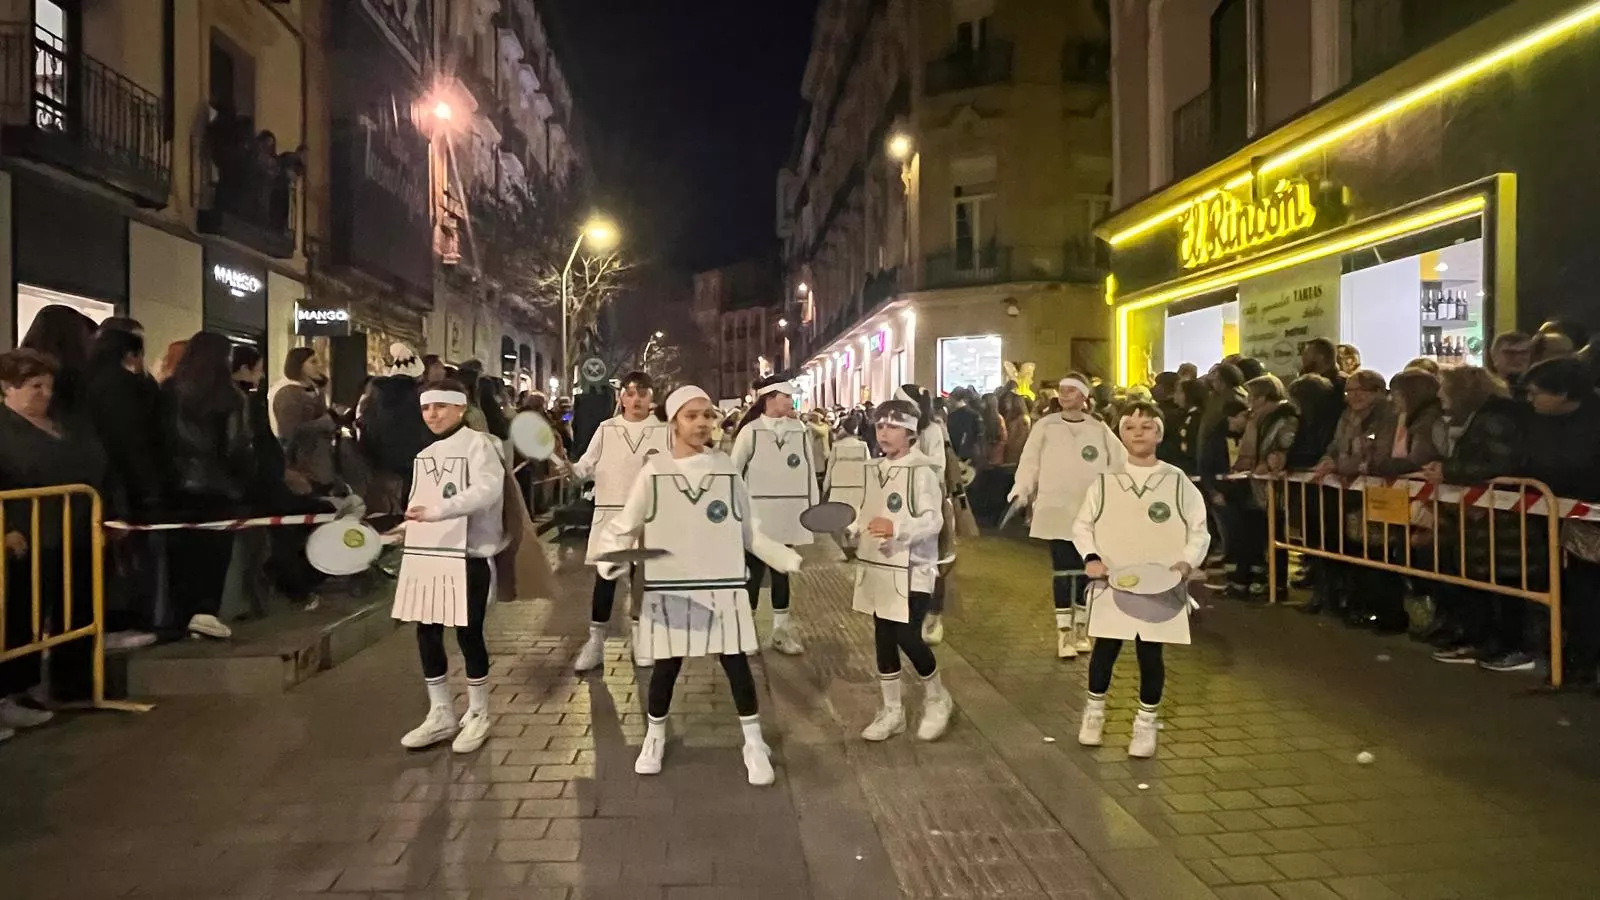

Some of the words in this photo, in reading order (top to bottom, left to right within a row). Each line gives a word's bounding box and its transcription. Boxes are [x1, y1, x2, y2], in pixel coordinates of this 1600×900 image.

[1179, 200, 1209, 267] El
[1208, 178, 1316, 258] Rincón
[214, 264, 260, 292] MANGO
[298, 310, 349, 321] MANGO
